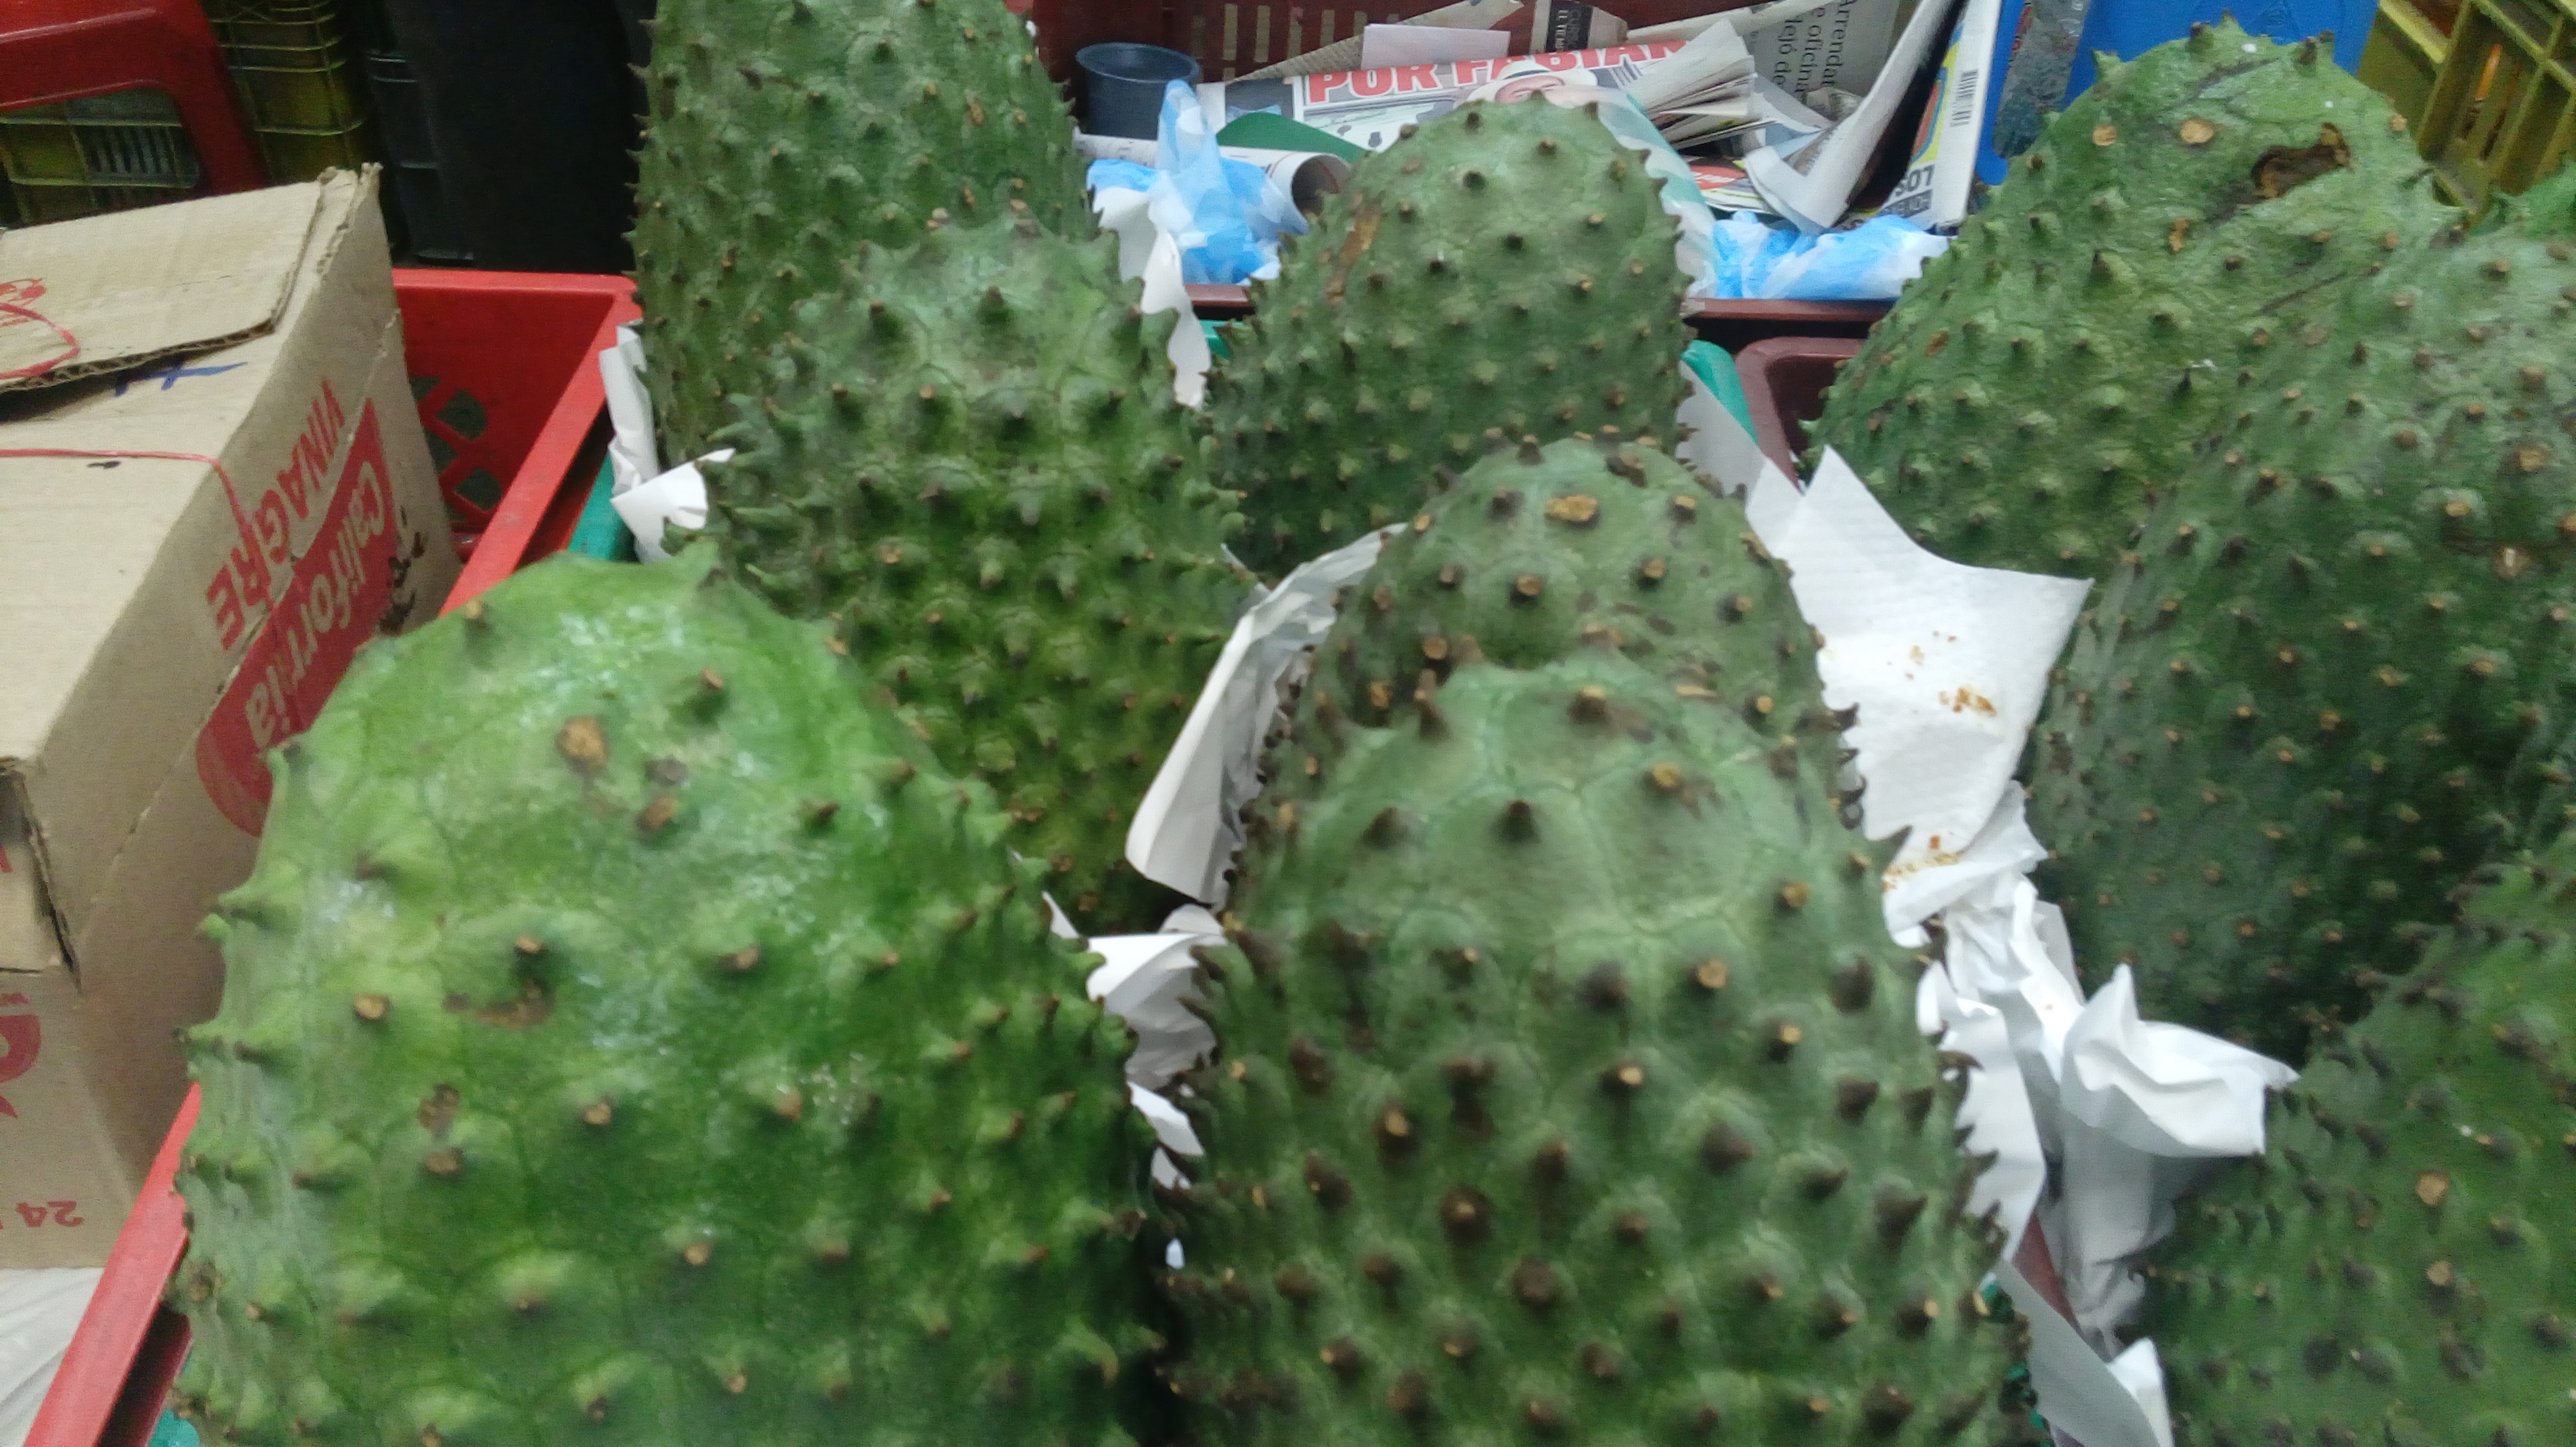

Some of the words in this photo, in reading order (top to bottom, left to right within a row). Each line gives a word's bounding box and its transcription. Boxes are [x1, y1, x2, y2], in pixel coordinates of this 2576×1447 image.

[1308, 63, 1438, 103] POR
[206, 380, 346, 651] VINAGRE
[246, 460, 386, 745] California
[15, 1200, 84, 1228] 24
